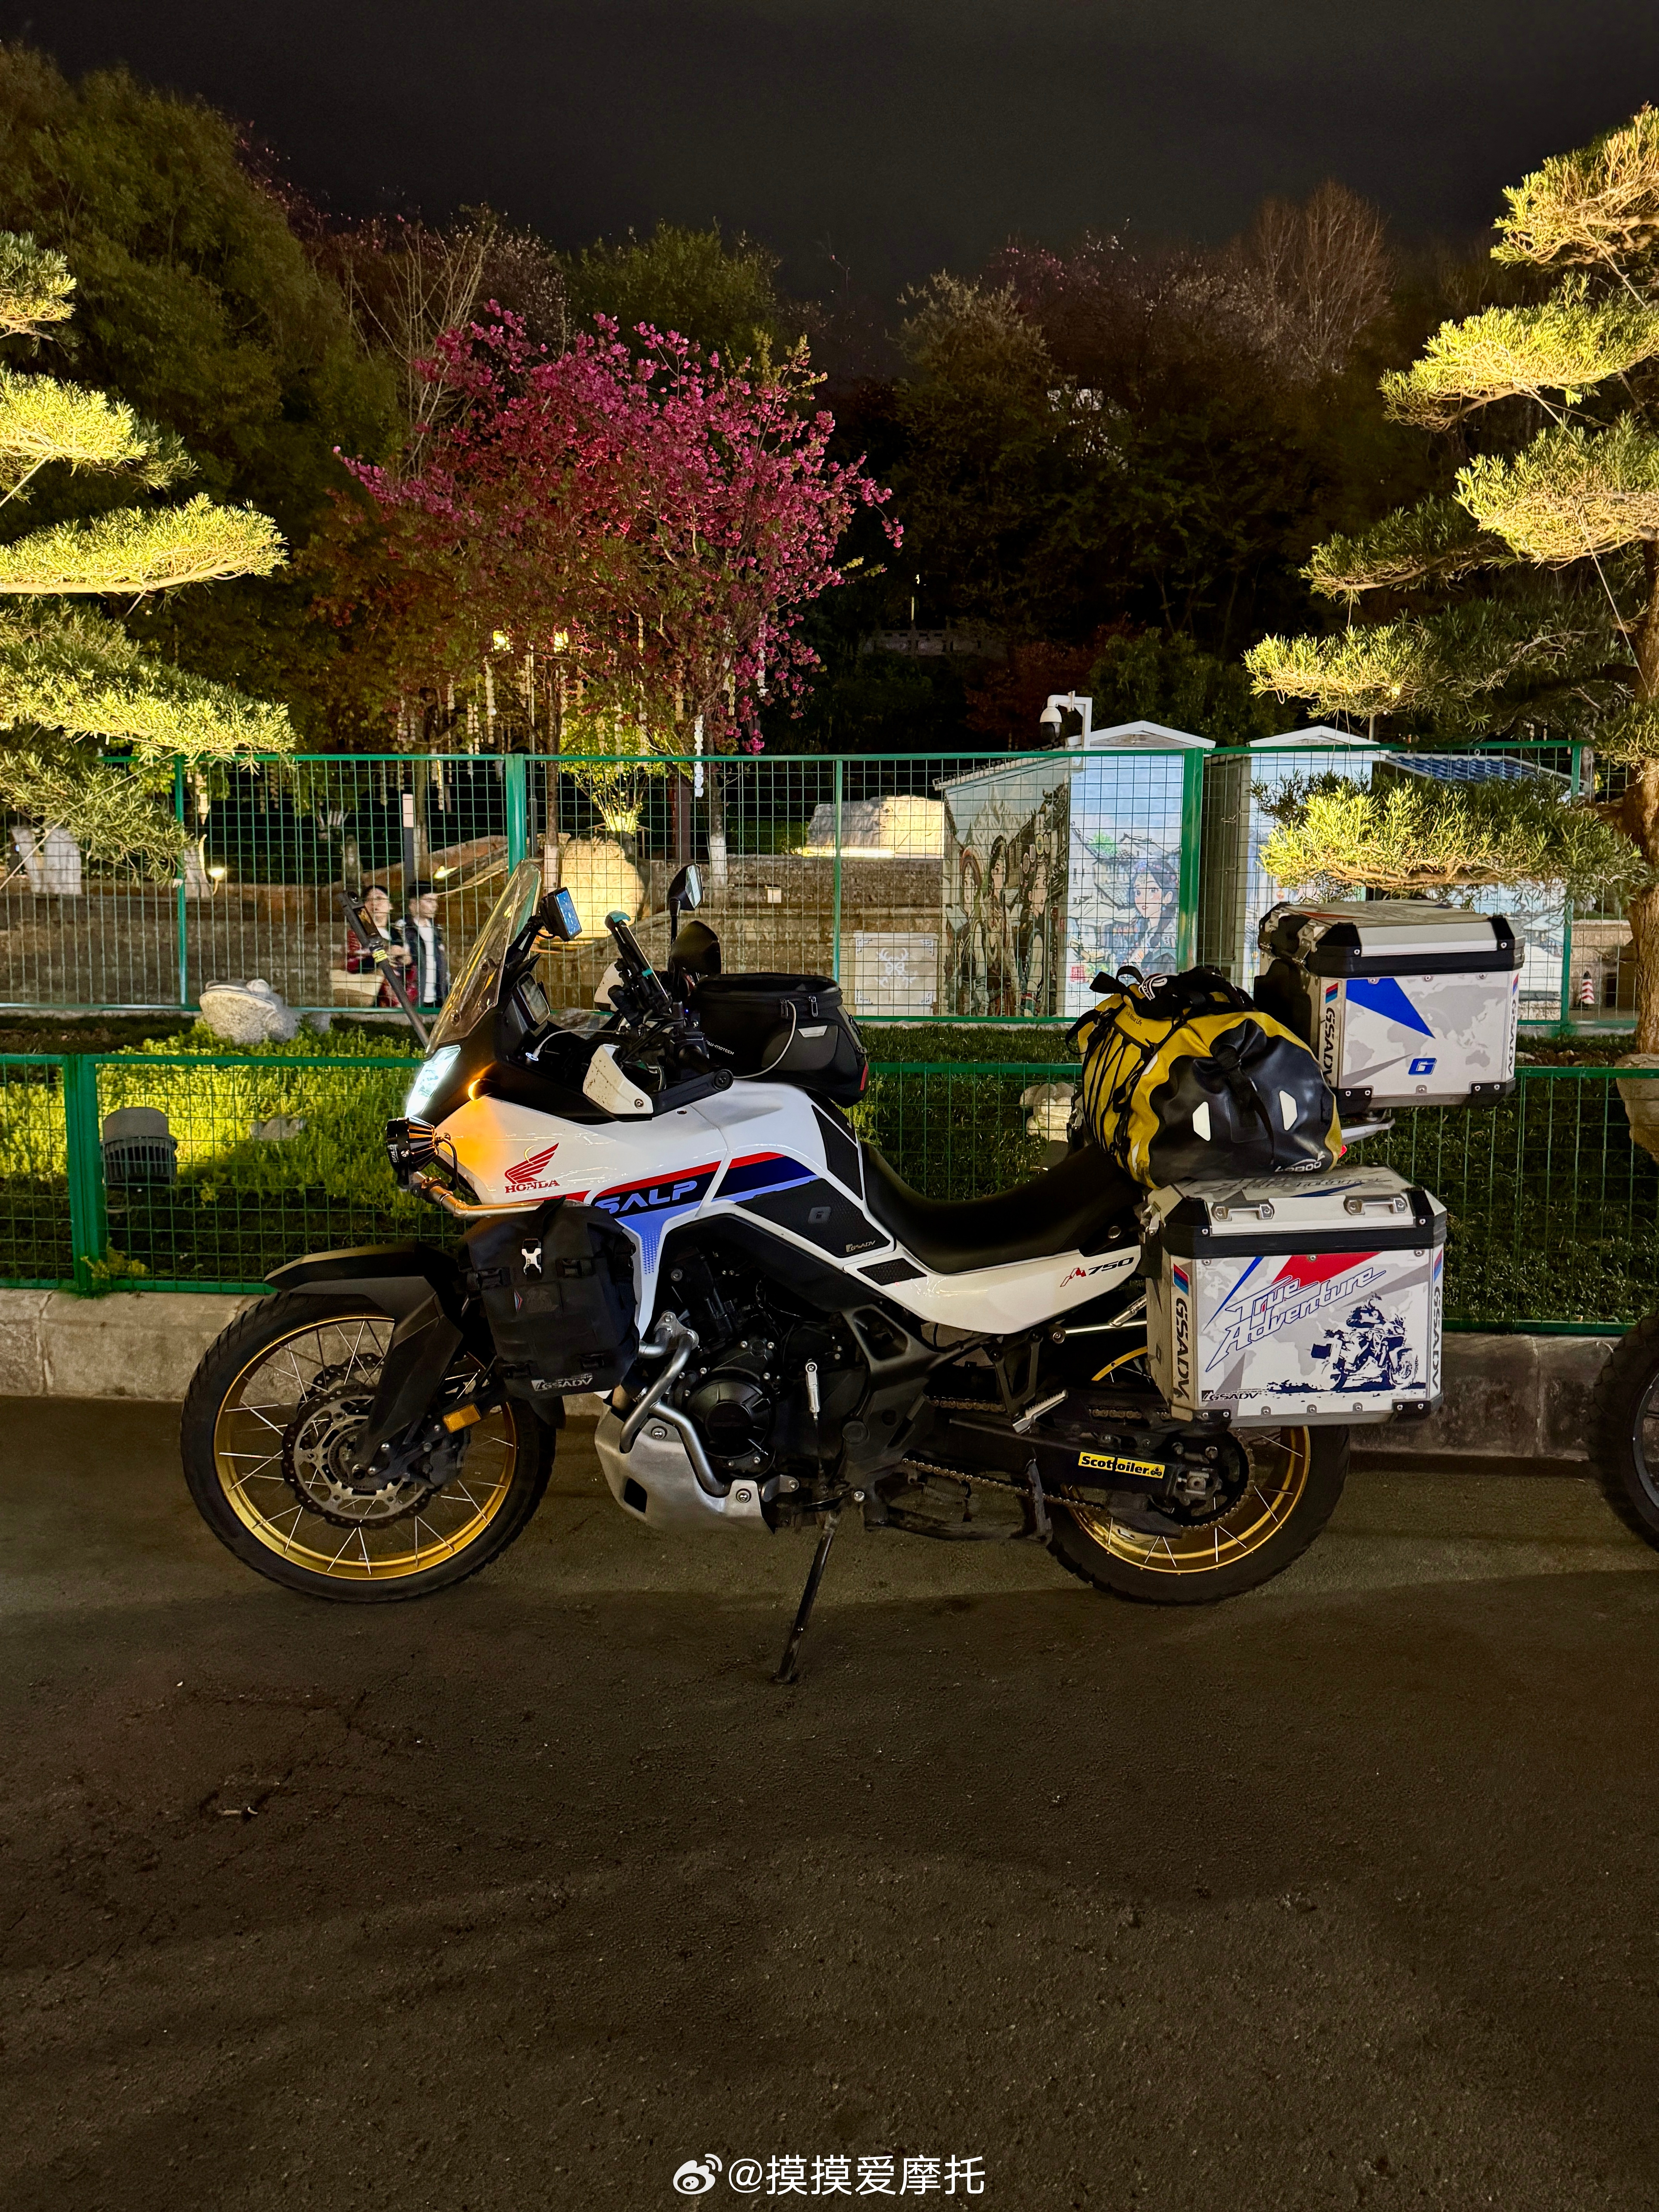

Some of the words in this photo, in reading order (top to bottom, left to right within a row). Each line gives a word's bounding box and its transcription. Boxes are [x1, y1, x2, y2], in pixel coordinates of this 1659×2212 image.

[505, 1179, 560, 1194] HONDA
[595, 1181, 697, 1214] SALP
[1088, 1257, 1134, 1276] 750
[1225, 1275, 1319, 1321] True
[1206, 1267, 1386, 1372] Adventure
[1176, 1298, 1190, 1401] GSADV
[541, 1377, 593, 1390] GSADV
[1209, 1392, 1259, 1401] GSADV
[1081, 1456, 1149, 1475] Scotoiler
